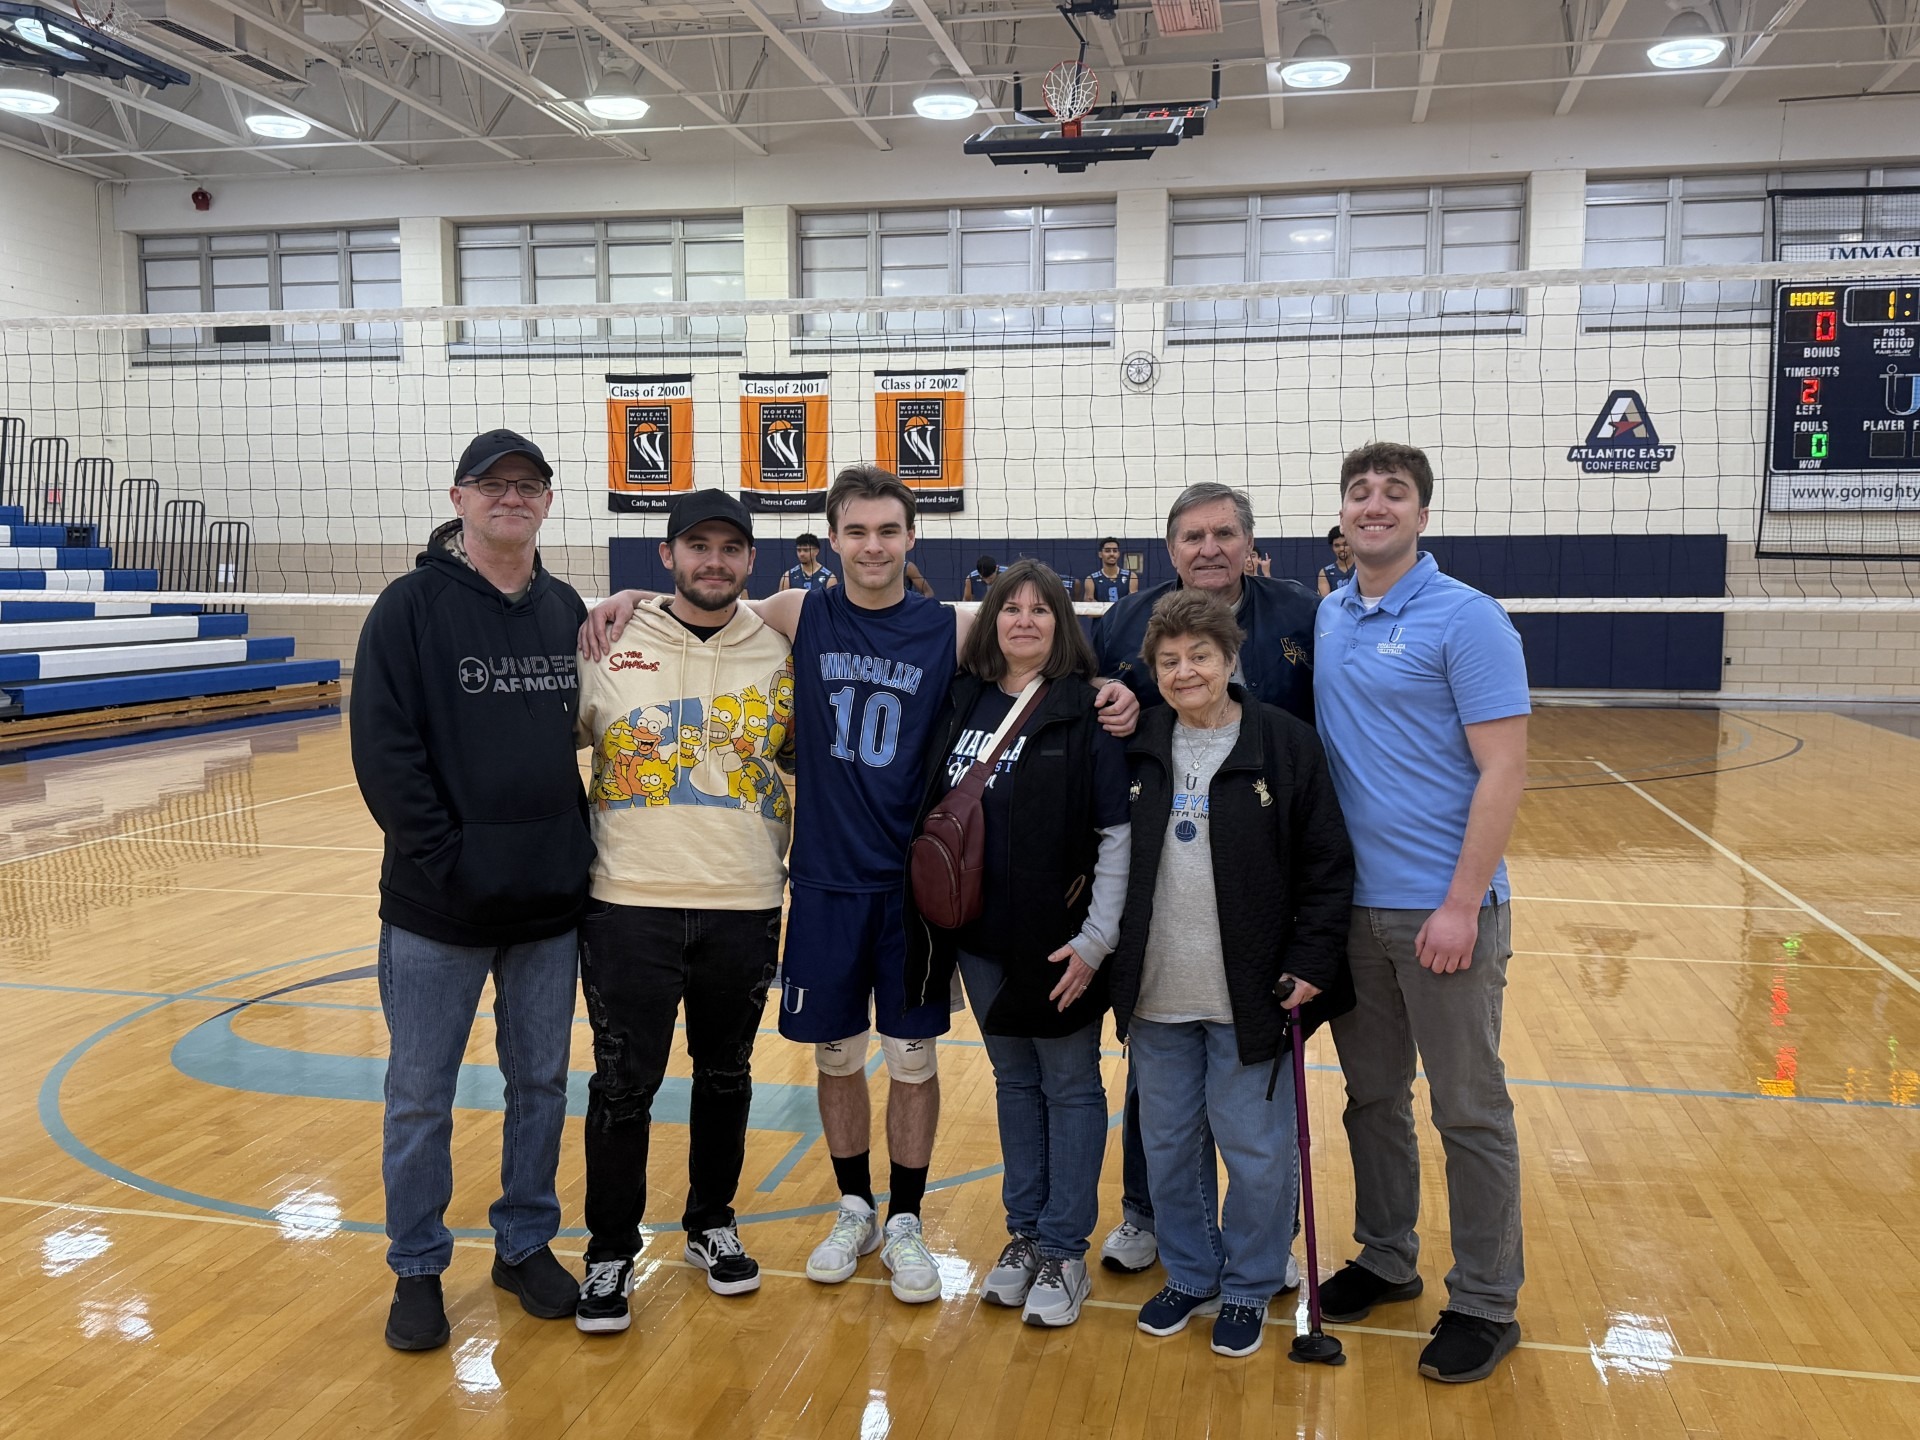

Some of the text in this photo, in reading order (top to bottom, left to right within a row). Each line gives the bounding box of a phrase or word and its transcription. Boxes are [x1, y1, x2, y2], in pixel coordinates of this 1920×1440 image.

[1790, 291, 1835, 306] HOME
[1815, 311, 1836, 341] 0
[1883, 328, 1905, 337] POSS
[1873, 338, 1914, 349] PERIOD
[1803, 346, 1840, 358] BONUS
[1784, 366, 1840, 378] TIMEOUTS
[745, 382, 820, 395] Class of 2001
[882, 378, 958, 390] Class of 2002
[611, 385, 685, 398] Class of 2000
[1802, 379, 1819, 403] 2
[1795, 404, 1822, 415] LEFT
[1794, 421, 1828, 432] FOULS
[1863, 420, 1905, 431] PLAYER
[1811, 434, 1828, 457] 0
[1571, 448, 1673, 459] ATLANTIC EAST
[1585, 461, 1657, 470] CONFERENCE
[1799, 460, 1822, 469] WON
[820, 652, 923, 695] IMMACULATA
[829, 686, 902, 767] 10
